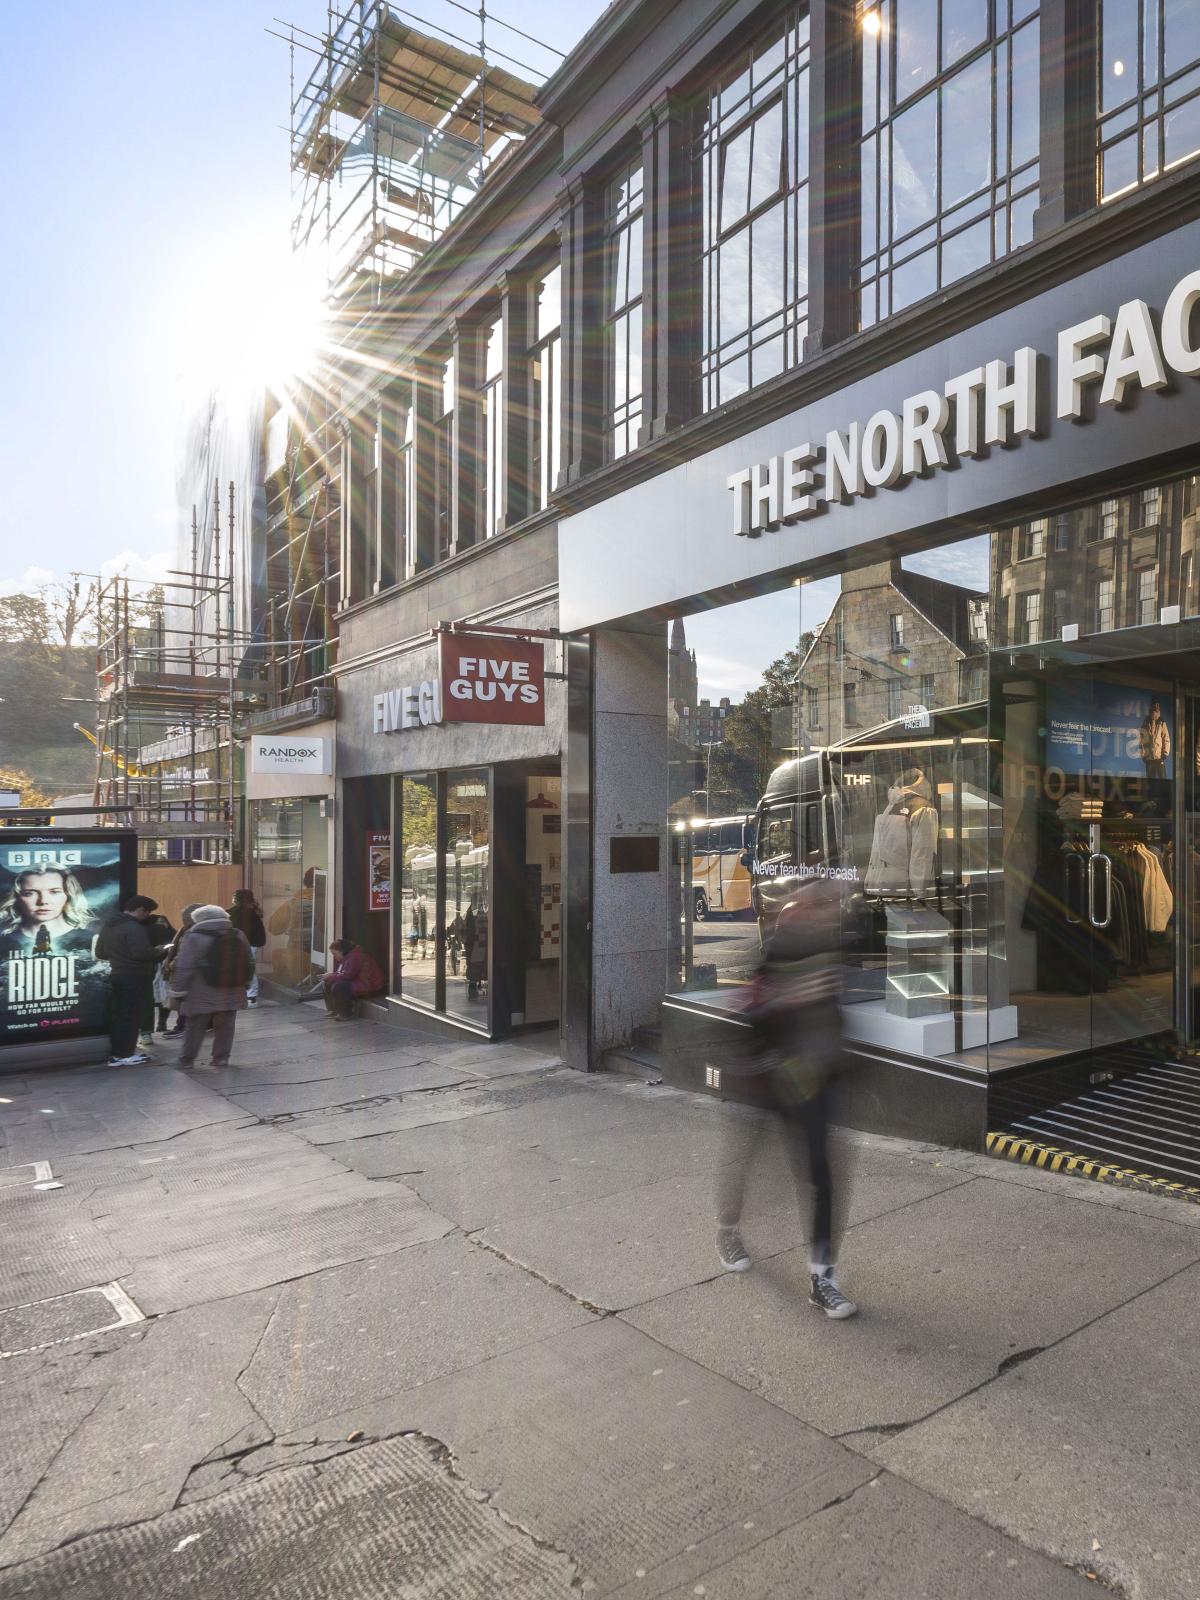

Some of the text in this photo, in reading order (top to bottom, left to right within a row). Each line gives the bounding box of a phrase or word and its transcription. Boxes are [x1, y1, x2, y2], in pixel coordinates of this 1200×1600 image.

[727, 442, 826, 536] THE
[826, 346, 1037, 503] NORTH
[458, 656, 530, 681] FIVE
[449, 678, 539, 704] GUYS
[373, 679, 443, 734] FIVE GU
[259, 747, 317, 758] RANDOX
[752, 859, 860, 881] Never fear the forecast.
[8, 956, 80, 1003] RIDGE
